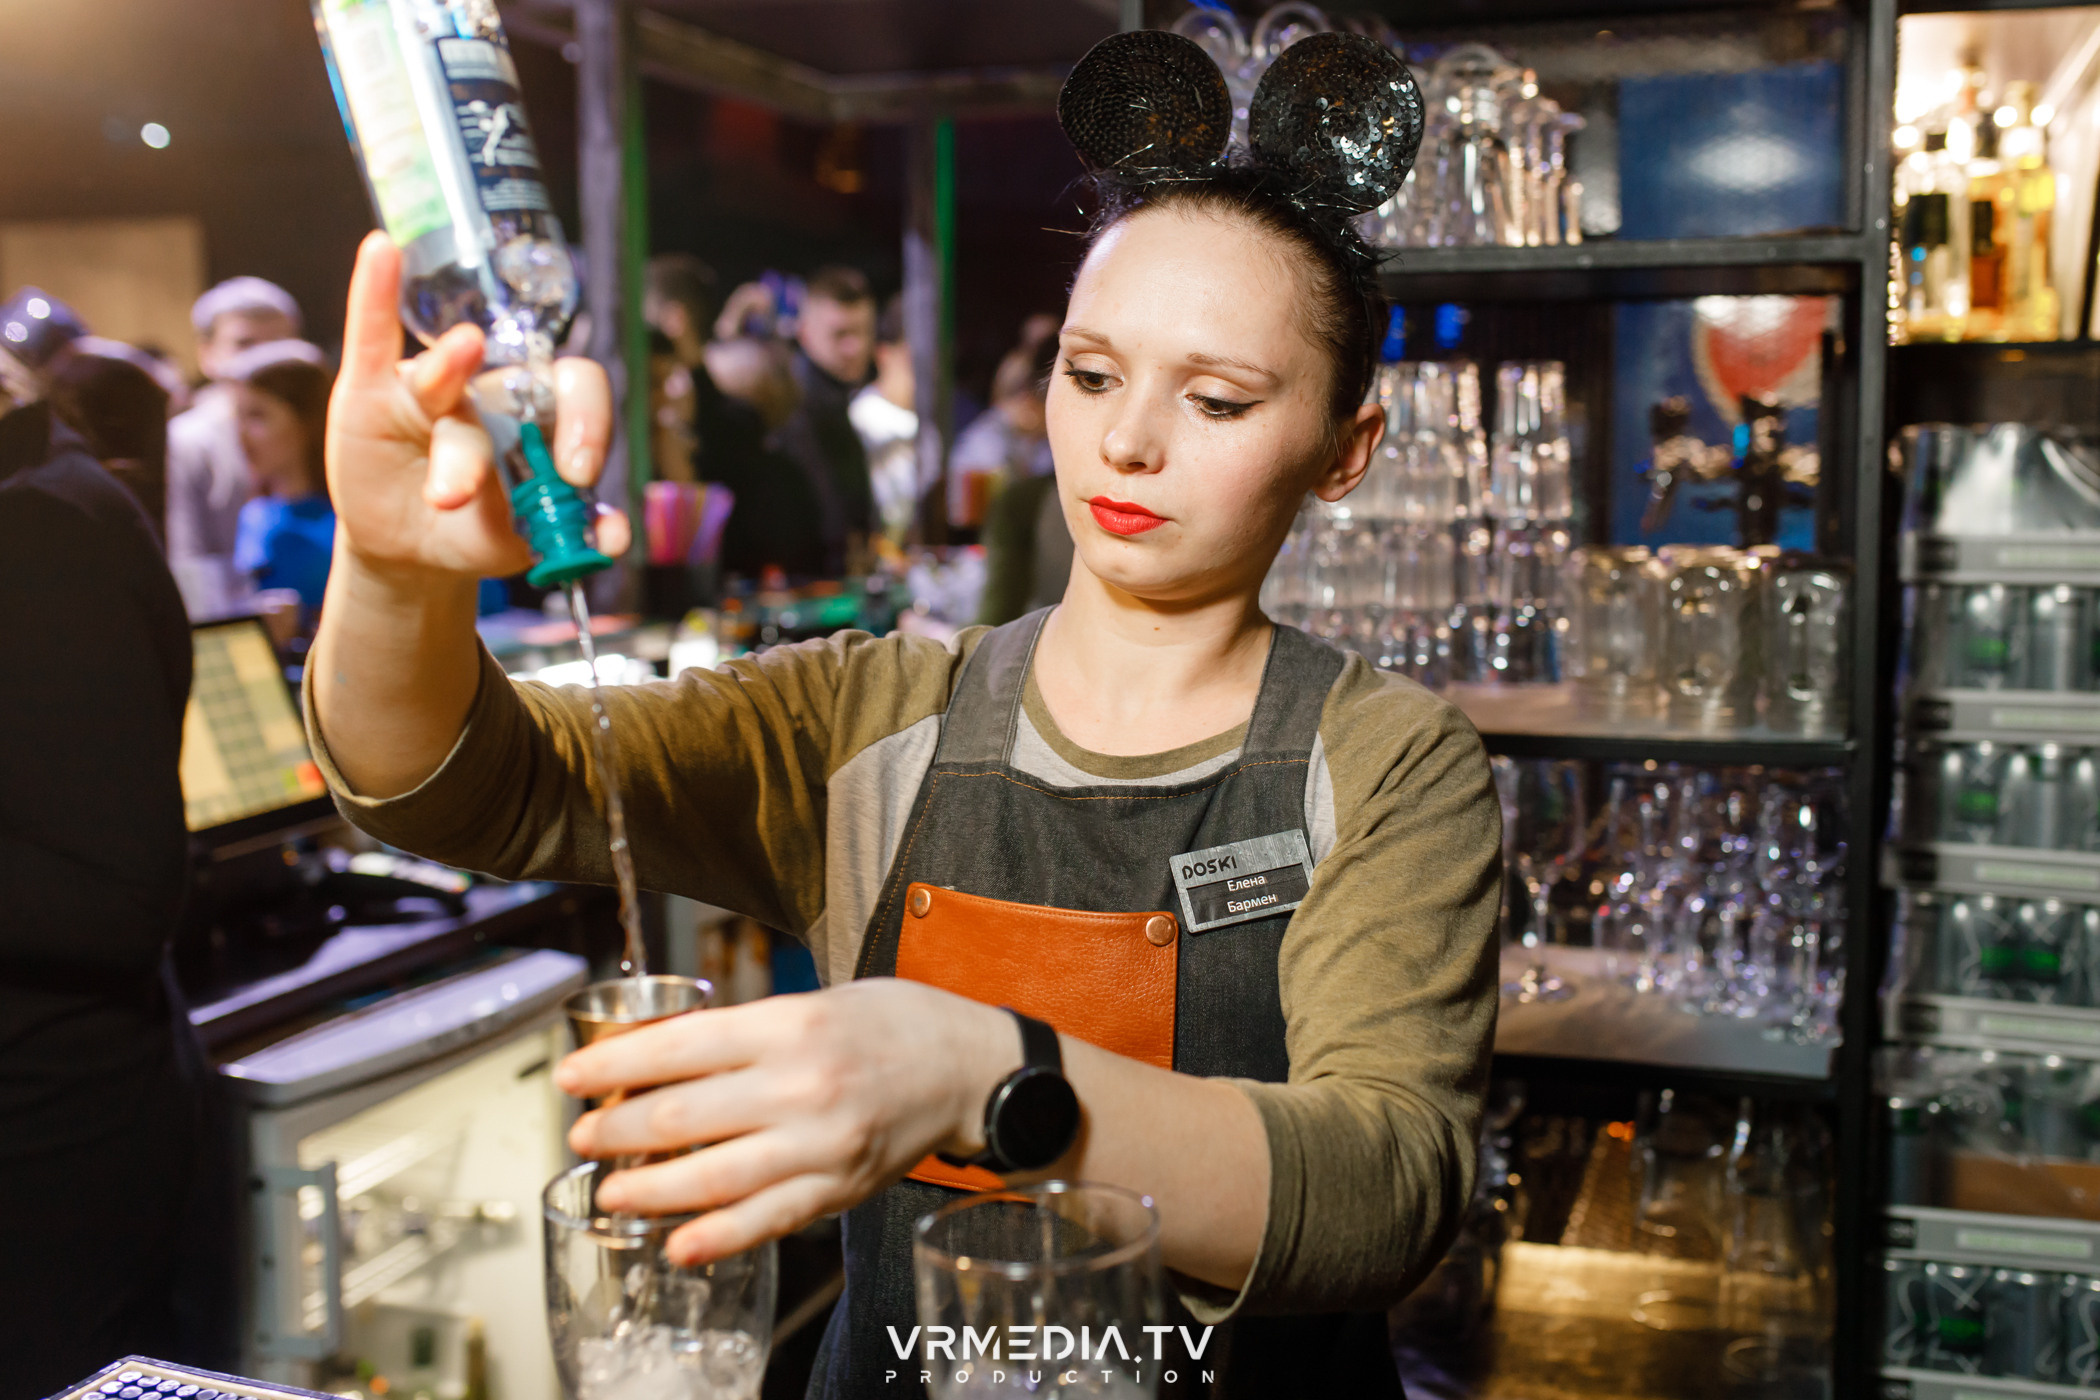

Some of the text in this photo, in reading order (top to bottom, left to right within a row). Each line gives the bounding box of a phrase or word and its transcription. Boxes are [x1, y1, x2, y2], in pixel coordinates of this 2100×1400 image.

[1182, 855, 1237, 879] DOSKI
[1227, 875, 1266, 891] Елена
[1227, 894, 1277, 912] Бармен
